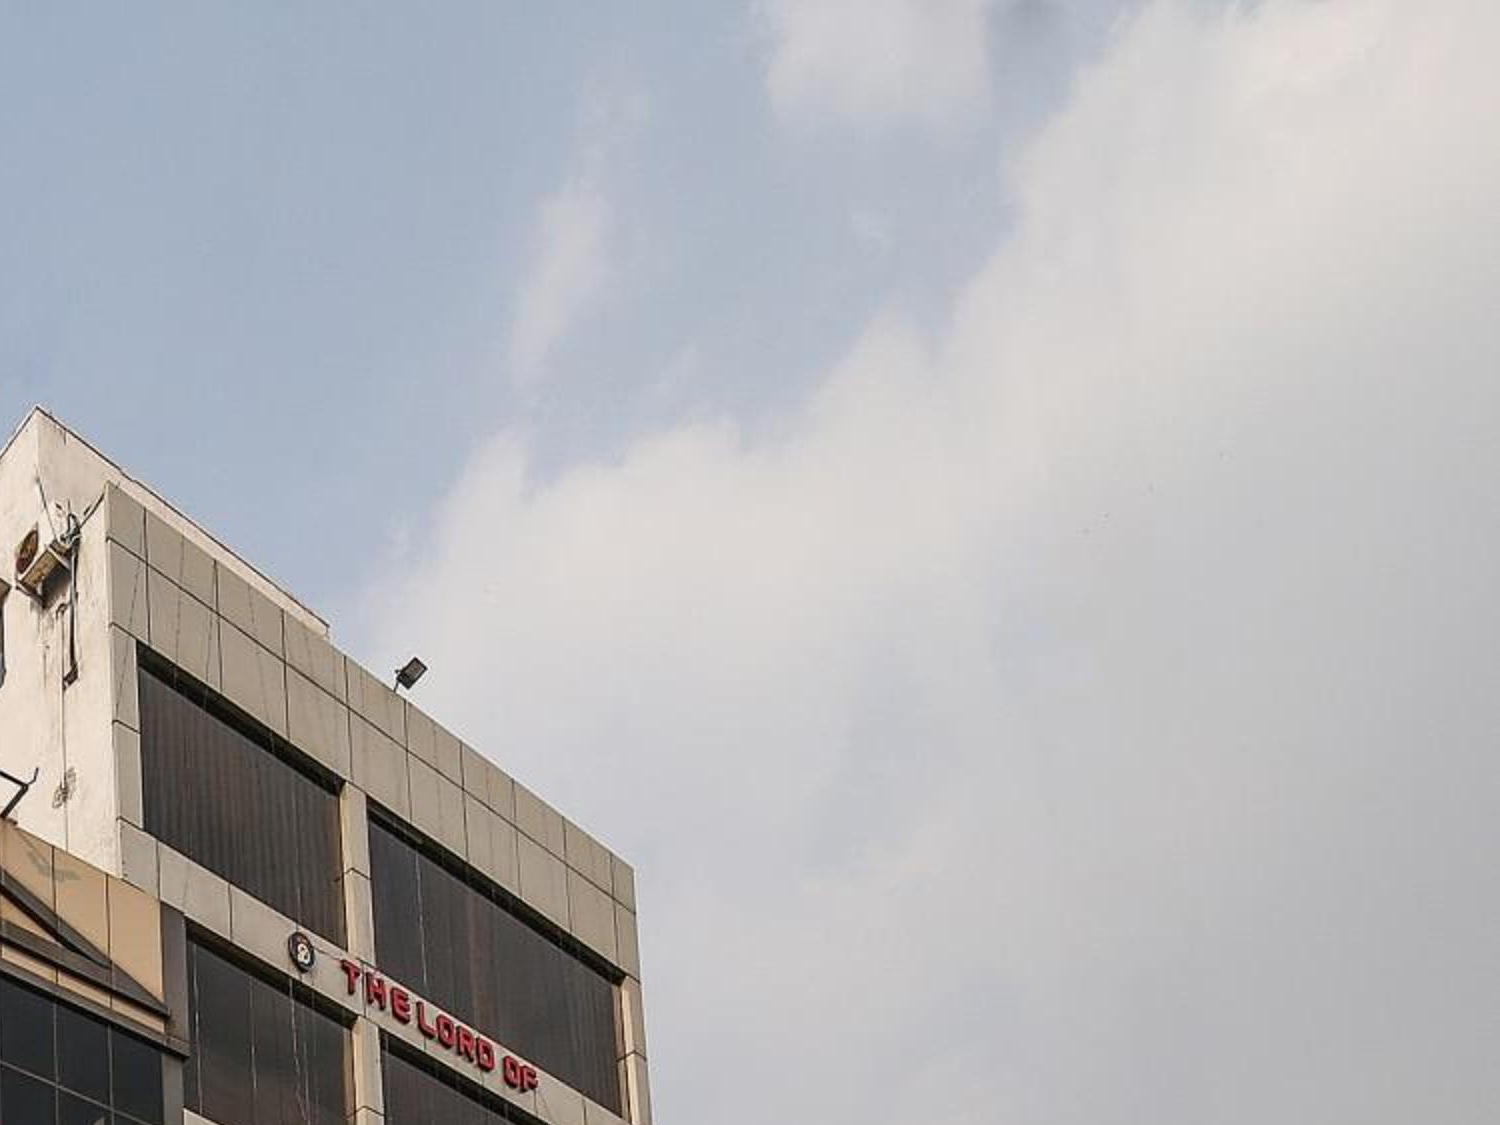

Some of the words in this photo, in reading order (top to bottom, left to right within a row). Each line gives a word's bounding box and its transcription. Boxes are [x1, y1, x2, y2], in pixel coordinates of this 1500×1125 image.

[340, 958, 411, 1025] THE
[416, 1000, 496, 1073] LORD
[503, 1055, 539, 1093] OF
